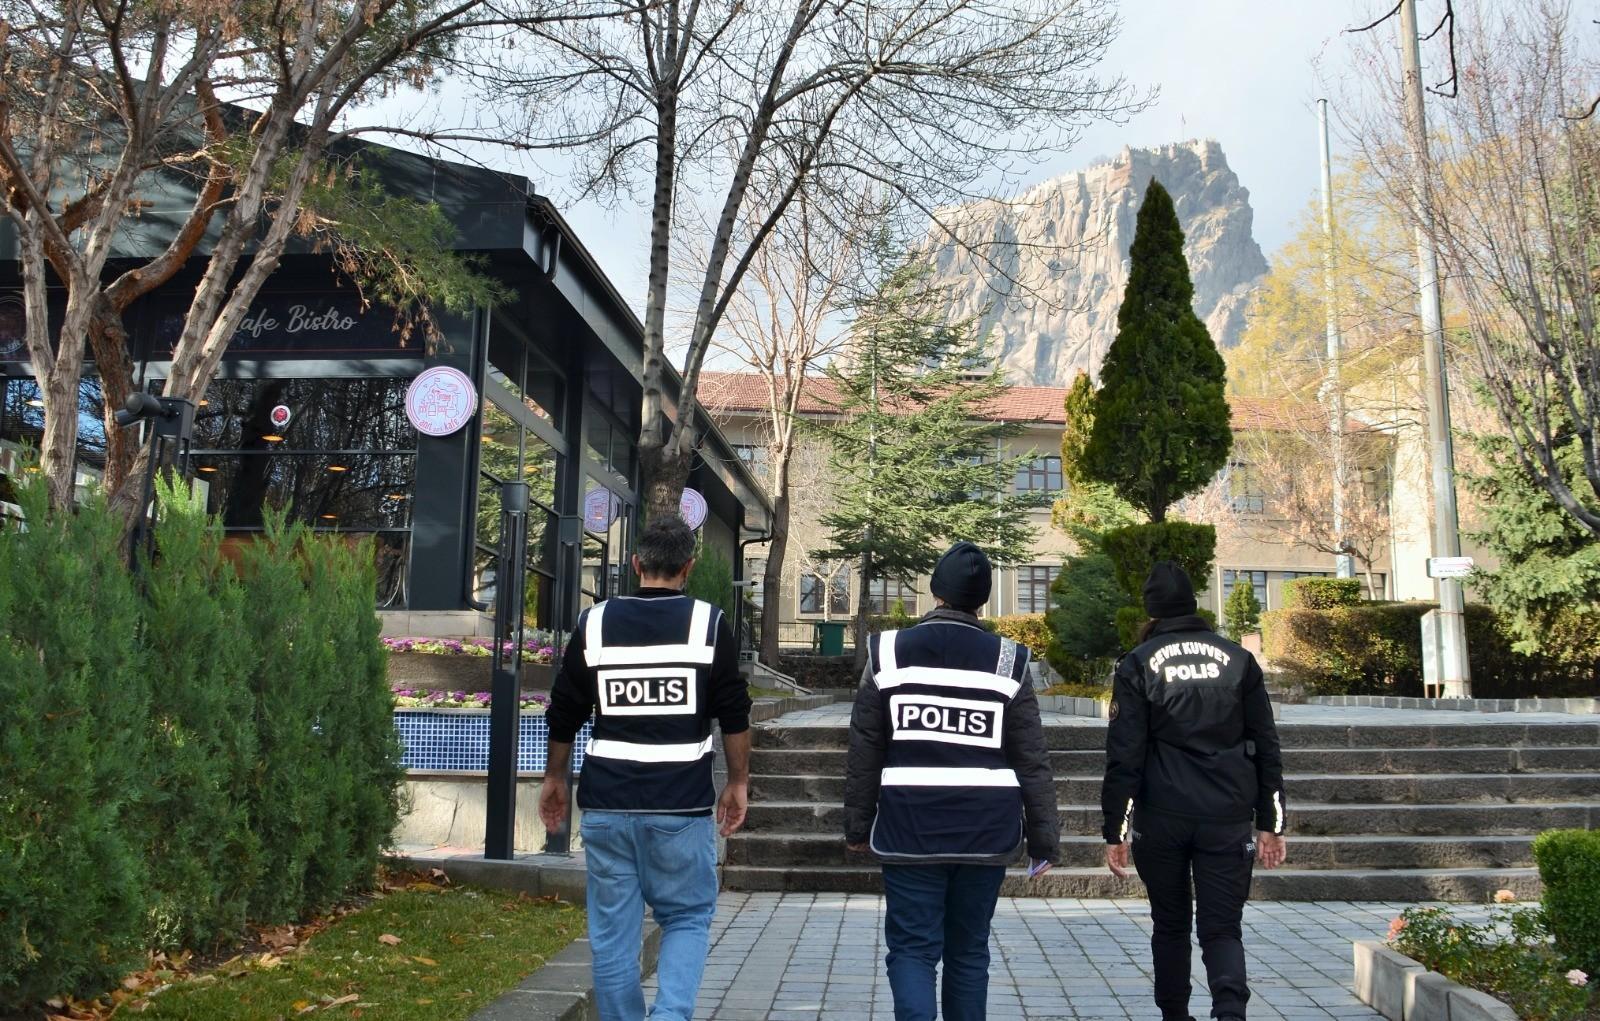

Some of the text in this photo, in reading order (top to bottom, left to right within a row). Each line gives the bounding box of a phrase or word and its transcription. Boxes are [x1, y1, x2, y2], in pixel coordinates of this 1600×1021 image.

[235, 304, 358, 338] afe Bistro
[1181, 641, 1231, 667] KUVVET
[1164, 662, 1220, 682] POLIS
